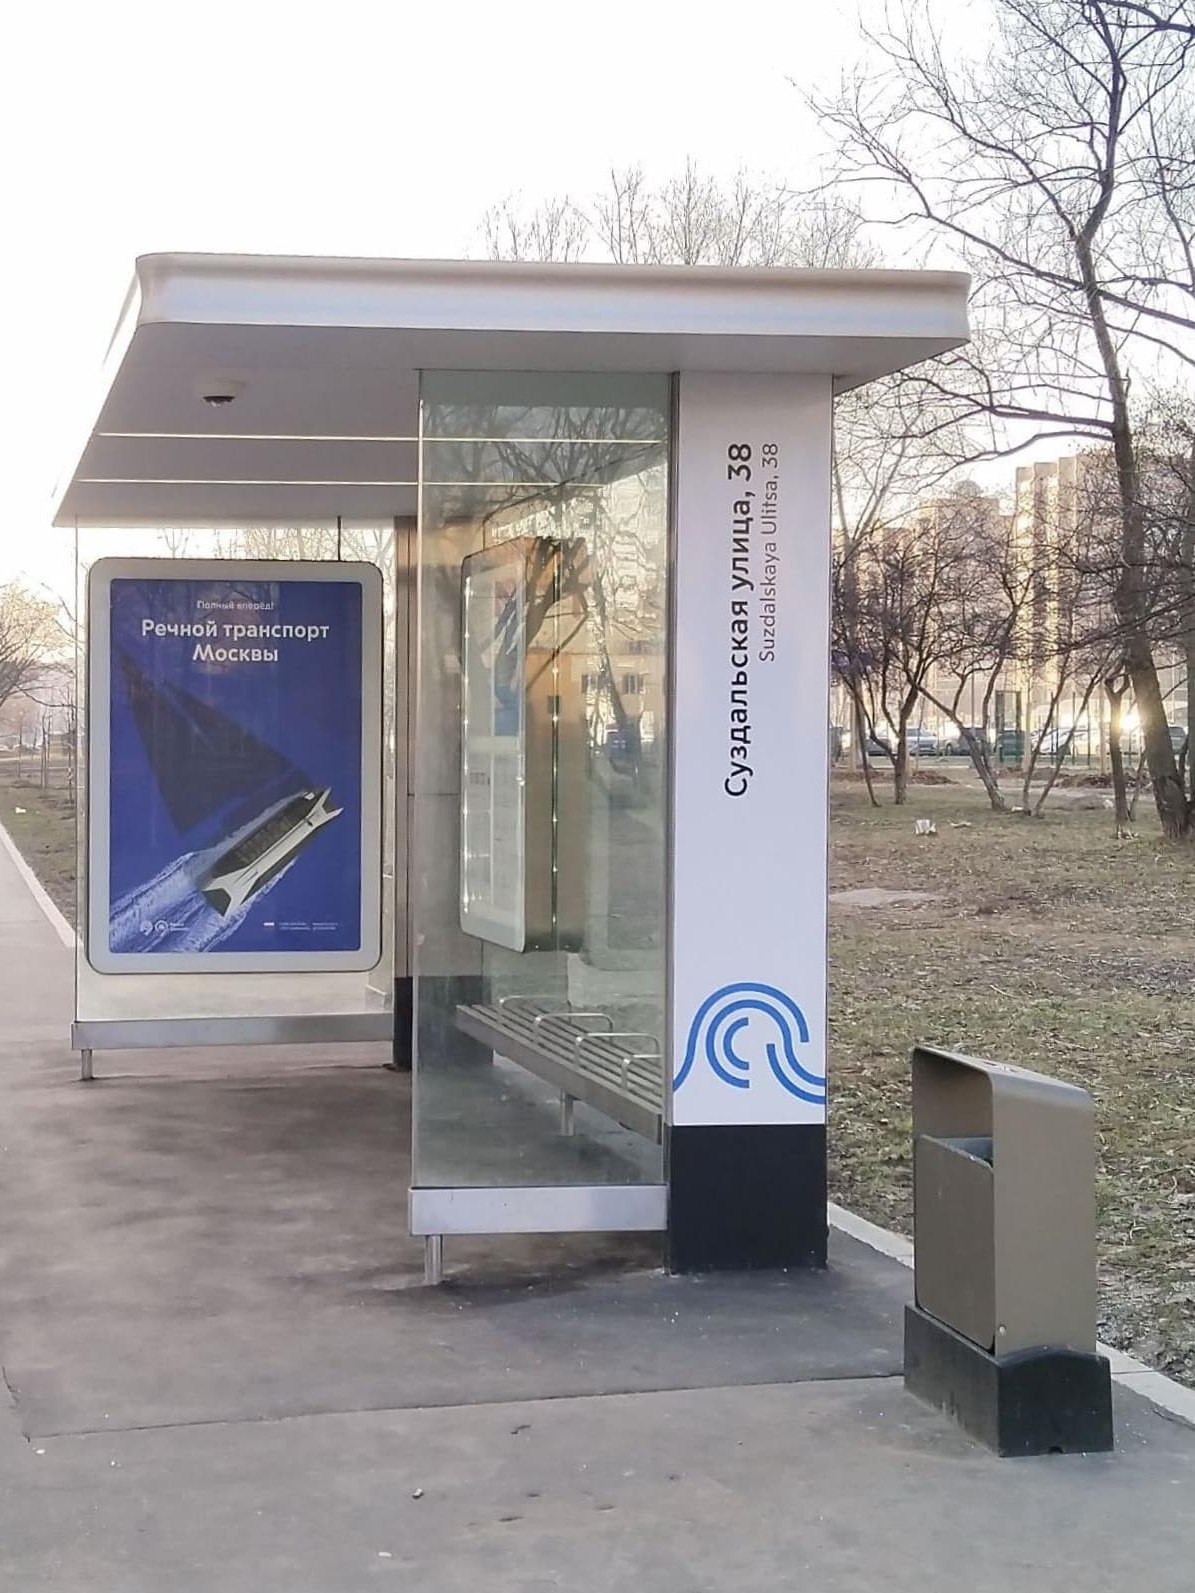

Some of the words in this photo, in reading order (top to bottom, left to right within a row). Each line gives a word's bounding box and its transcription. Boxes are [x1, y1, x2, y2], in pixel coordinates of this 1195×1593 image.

[728, 443, 752, 481] 38
[761, 443, 779, 468] 38
[760, 475, 779, 534] Ulitsa,
[732, 491, 755, 591] улица,
[759, 542, 780, 661] Suzdalskaya
[141, 619, 217, 637] Речной
[223, 624, 329, 641] транспорт
[192, 644, 278, 661] Москвы
[725, 600, 753, 796] Суздальская
